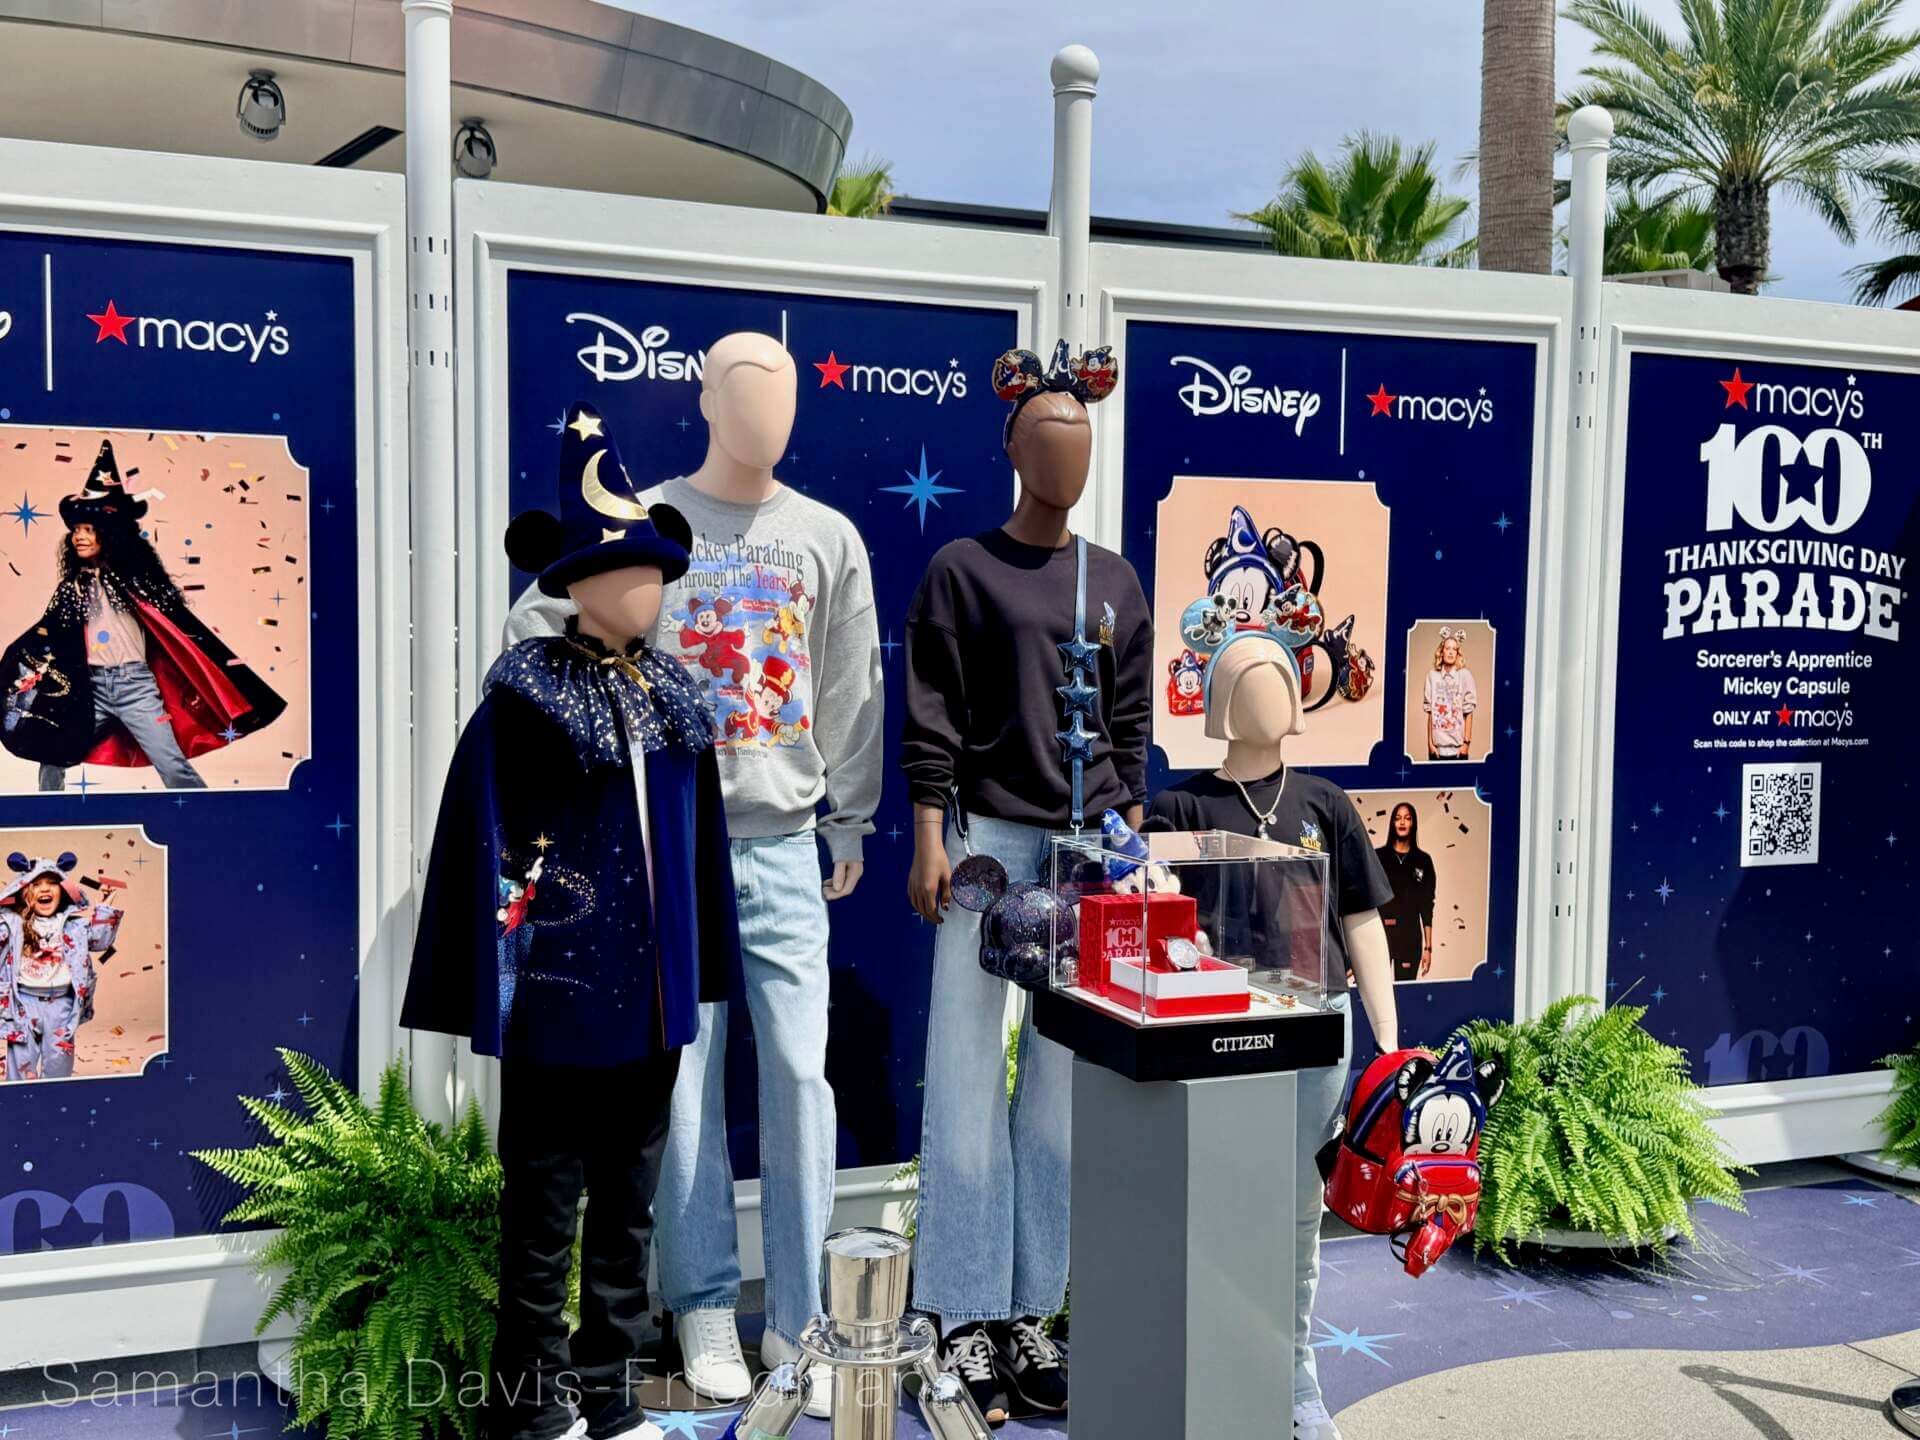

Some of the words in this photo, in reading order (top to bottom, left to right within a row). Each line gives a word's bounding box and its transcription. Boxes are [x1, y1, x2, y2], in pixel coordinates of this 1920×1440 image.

[565, 313, 705, 382] Disn
[1170, 355, 1320, 437] Disney
[688, 533, 730, 564] ickey
[734, 533, 804, 581] Parading
[1665, 539, 1854, 574] THANKSGIVING
[1860, 548, 1906, 580] DAY
[729, 564, 752, 589] The
[1662, 569, 1901, 642] PARADE
[1696, 649, 1782, 668] Sorcerer's
[1786, 650, 1873, 671] Apprentice
[1723, 677, 1782, 698] Mickey
[1786, 677, 1851, 698] Capsule
[1713, 711, 1751, 725] ONLY
[1752, 711, 1771, 725] AT
[1693, 739, 1713, 749] Scan
[1714, 739, 1727, 748] this
[1728, 739, 1747, 748] code
[1748, 739, 1756, 748] to
[1757, 739, 1775, 749] shop
[1775, 739, 1787, 747] the
[1788, 738, 1821, 747] collection
[1822, 738, 1830, 746] at
[1831, 737, 1869, 747] Macys.com
[1212, 1034, 1275, 1053] CITIZEN
